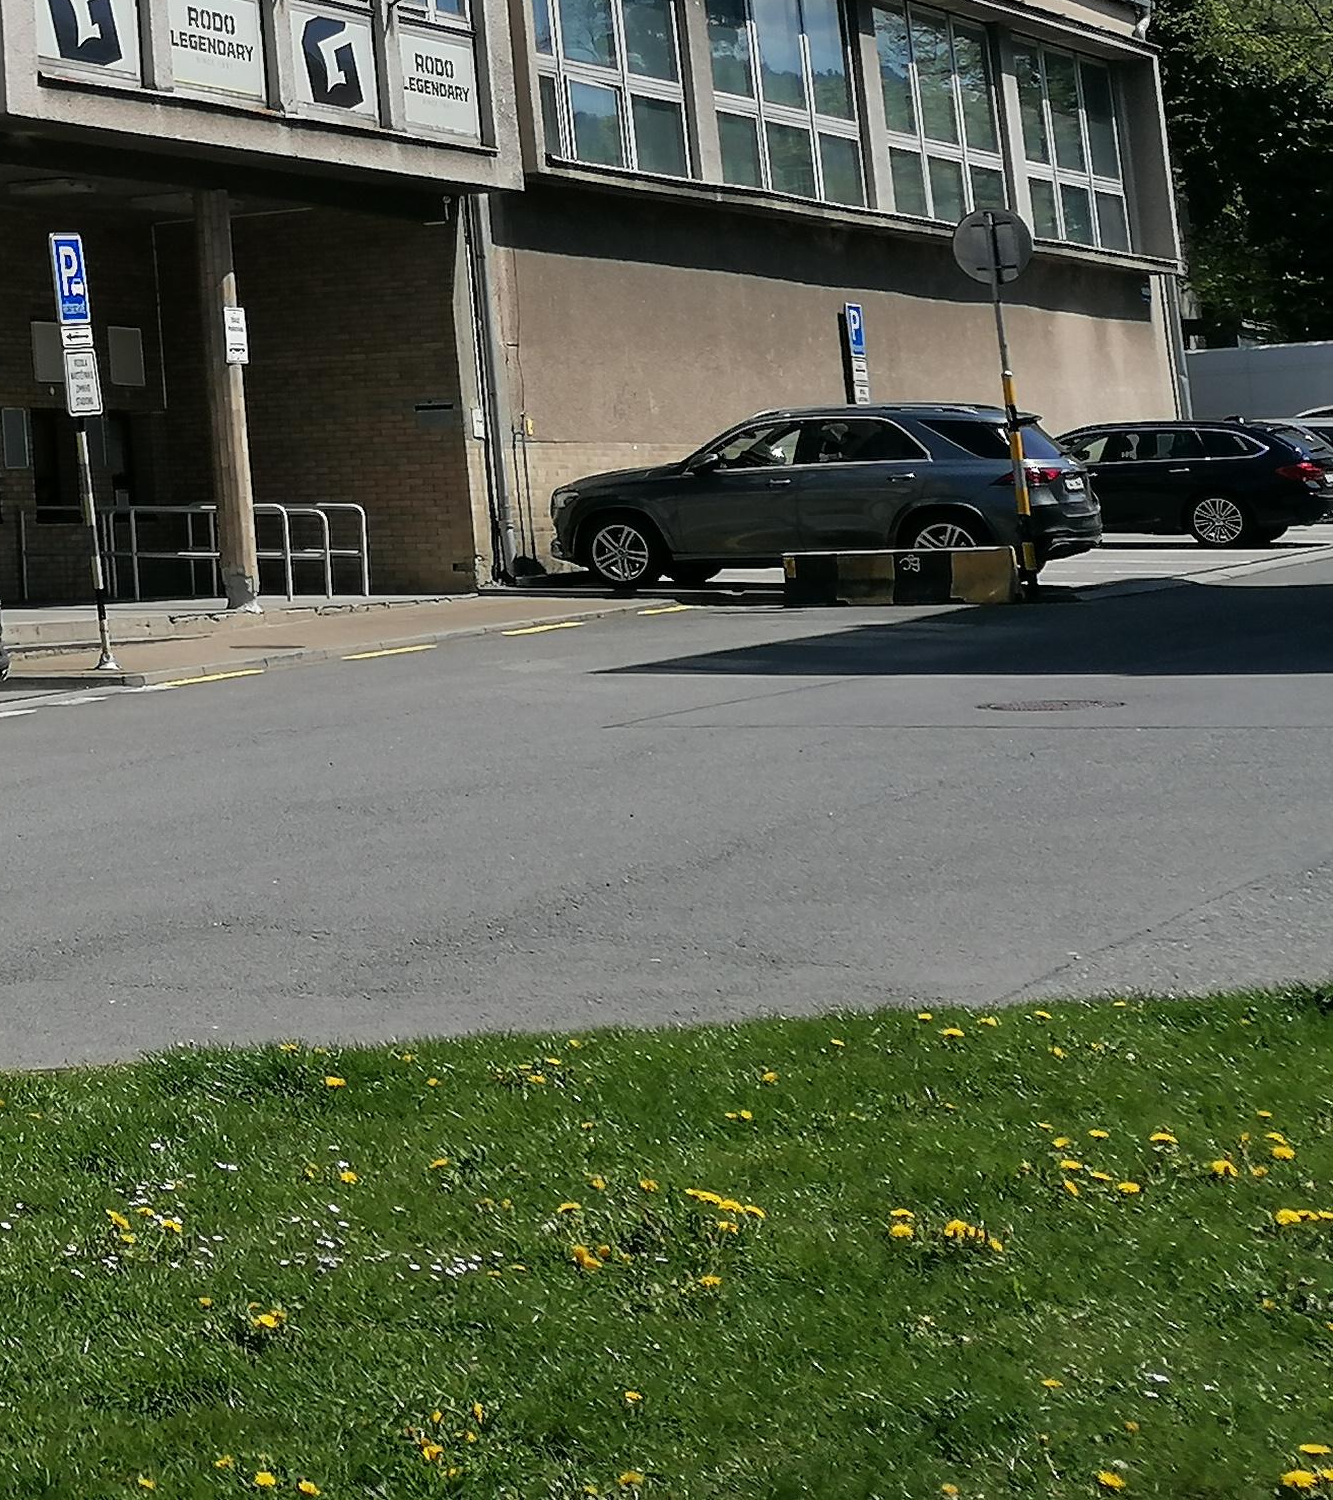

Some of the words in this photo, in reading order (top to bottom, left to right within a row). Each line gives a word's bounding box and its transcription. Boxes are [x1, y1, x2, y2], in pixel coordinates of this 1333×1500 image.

[187, 6, 235, 35] RODO
[170, 29, 254, 62] LEGENDARY
[415, 52, 454, 78] RODO
